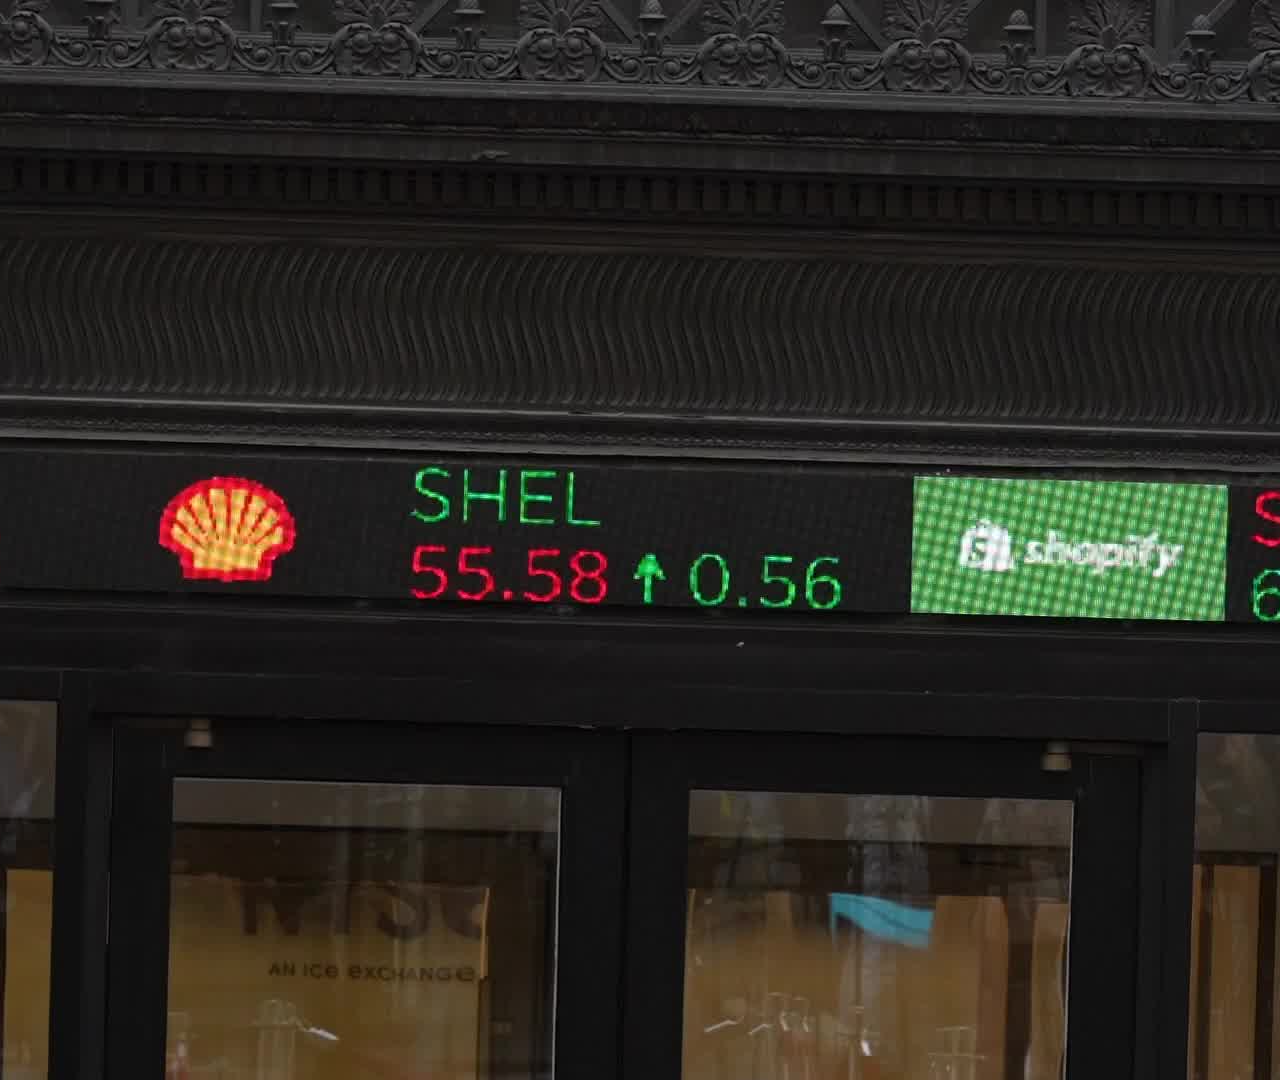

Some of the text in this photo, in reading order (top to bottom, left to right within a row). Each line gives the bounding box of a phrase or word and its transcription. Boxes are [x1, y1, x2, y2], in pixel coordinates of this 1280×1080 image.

[411, 467, 602, 527] SHEL
[409, 545, 843, 610] 55.58 0.56
[1023, 529, 1186, 578] shopify
[268, 960, 296, 977] AN
